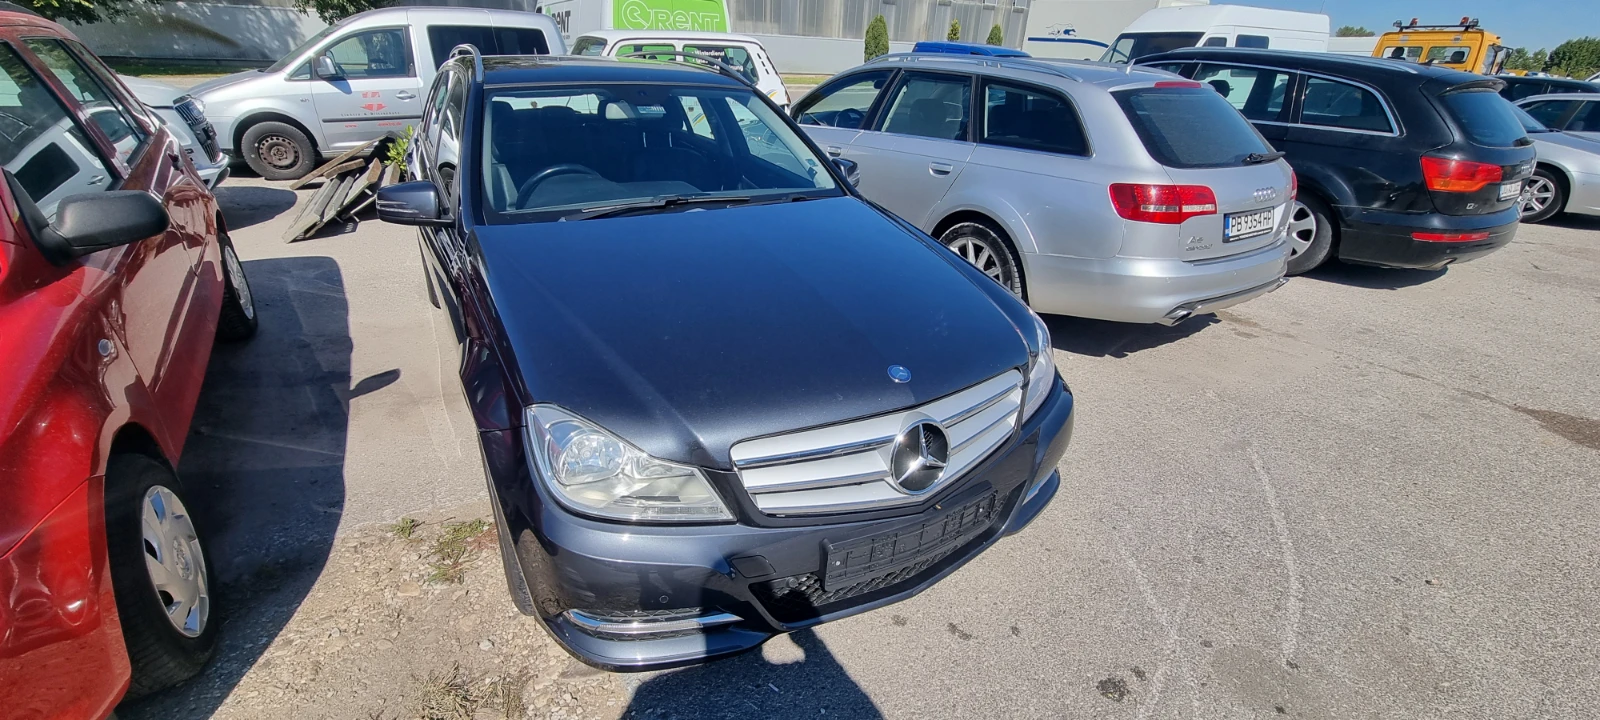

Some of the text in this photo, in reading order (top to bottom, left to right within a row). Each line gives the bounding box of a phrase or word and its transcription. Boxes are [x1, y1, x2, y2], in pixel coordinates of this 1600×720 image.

[1231, 210, 1272, 234] PB 9354 HP
